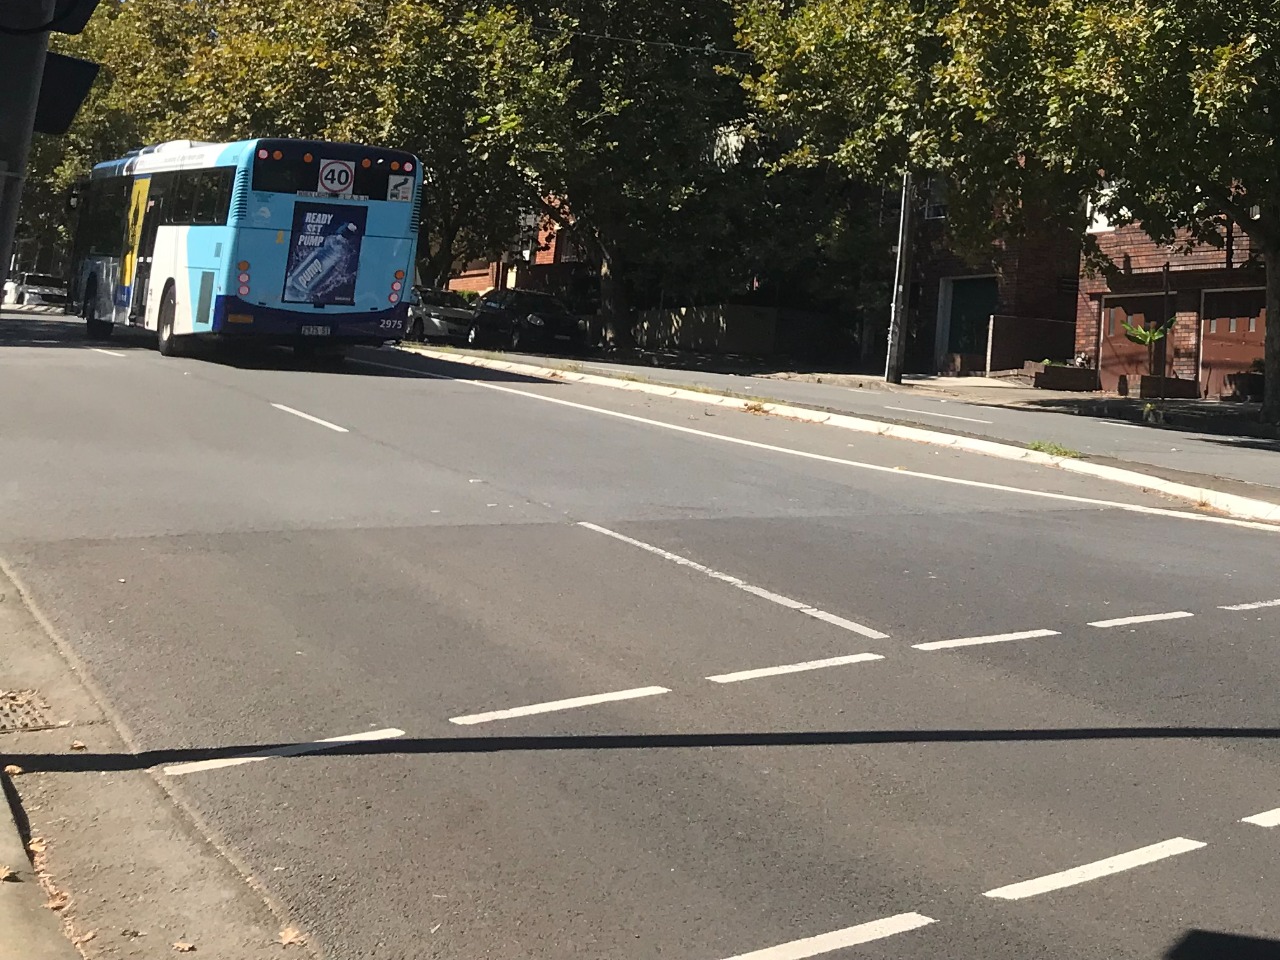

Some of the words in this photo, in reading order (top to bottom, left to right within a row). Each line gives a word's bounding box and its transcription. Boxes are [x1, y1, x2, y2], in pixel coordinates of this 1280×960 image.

[324, 169, 350, 186] 40
[305, 212, 334, 225] READY
[305, 224, 323, 235] SET
[298, 235, 324, 246] PUMP
[298, 258, 322, 288] pump
[379, 319, 403, 329] 2975
